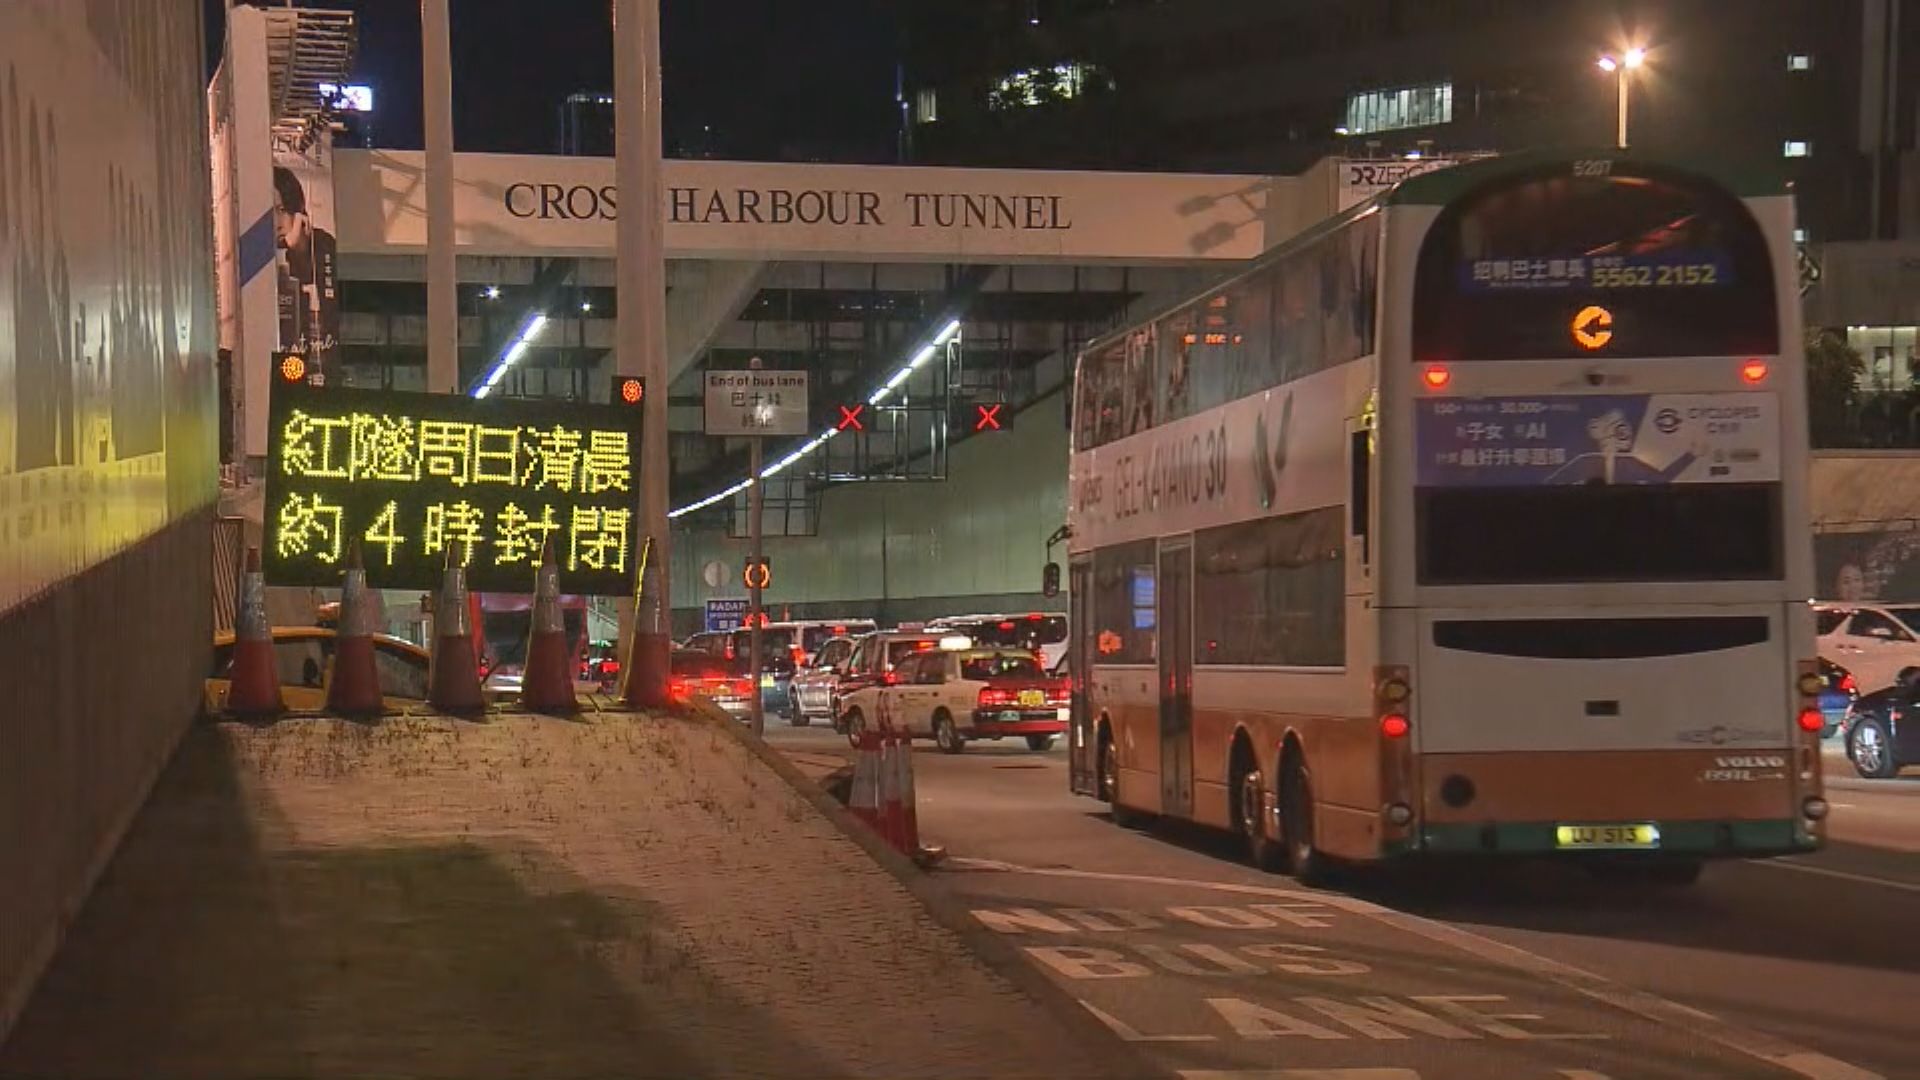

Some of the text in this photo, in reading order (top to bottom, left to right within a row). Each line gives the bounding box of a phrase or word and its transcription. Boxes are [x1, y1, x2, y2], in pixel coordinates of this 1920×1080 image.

[504, 182, 1072, 230] CROS HARBOUR TUNNEL
[1592, 264, 1717, 287] 5562 2152
[752, 375, 775, 387] bus
[777, 375, 805, 387] lane
[281, 409, 633, 494] 紅隧周日清晨
[1205, 423, 1227, 502] 30
[1714, 756, 1785, 768] VOLVO
[1022, 943, 1373, 980] BUS
[1076, 995, 1612, 1042] LANE
